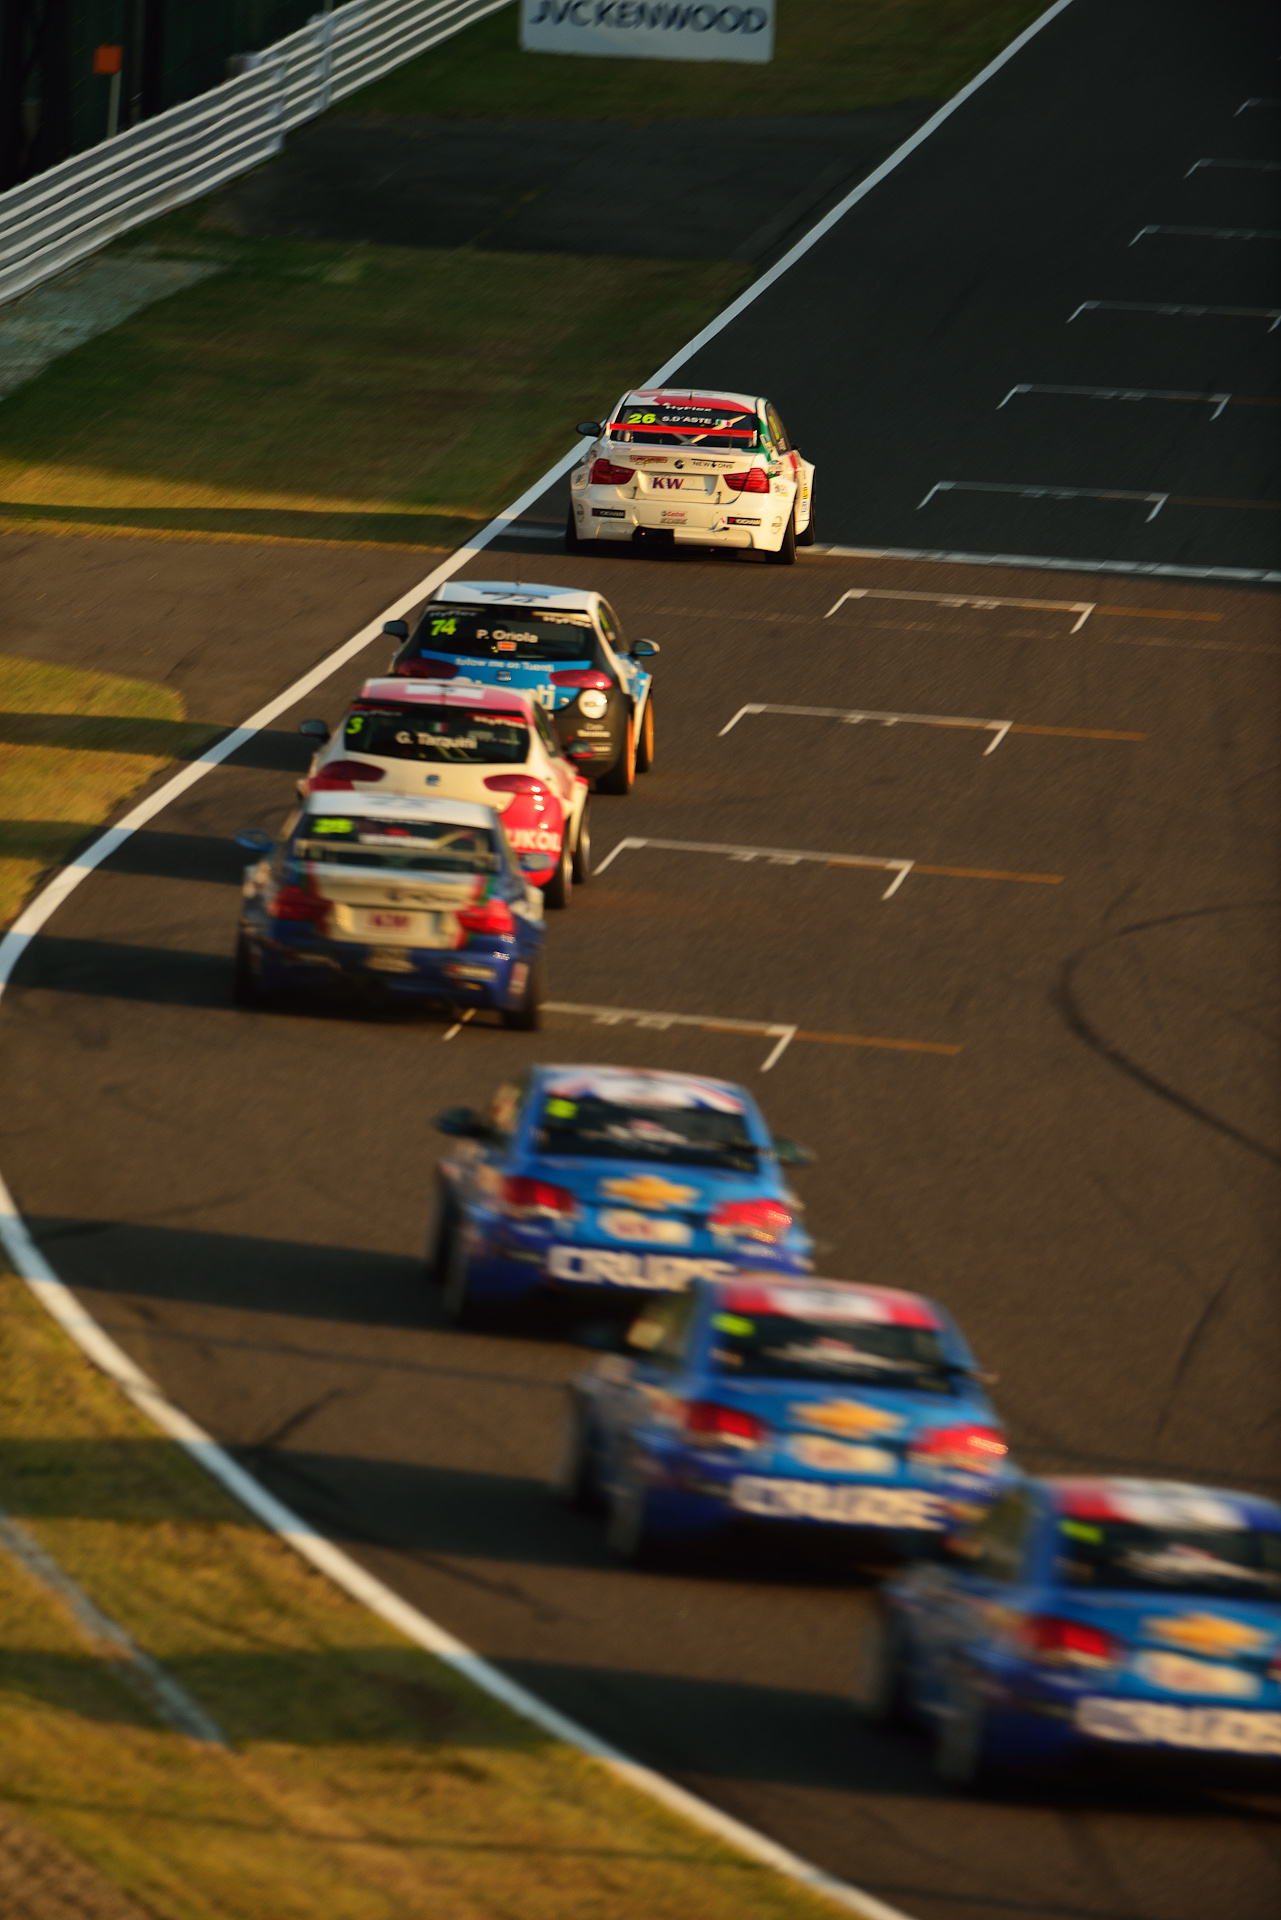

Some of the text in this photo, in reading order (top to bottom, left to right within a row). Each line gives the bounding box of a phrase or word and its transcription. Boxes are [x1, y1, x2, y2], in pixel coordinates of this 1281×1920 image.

[627, 413, 656, 424] 26
[652, 477, 685, 490] KW
[430, 618, 457, 636] 74
[476, 629, 539, 643] P. Oriola
[346, 717, 364, 734] 3
[505, 828, 562, 852] UKOIL
